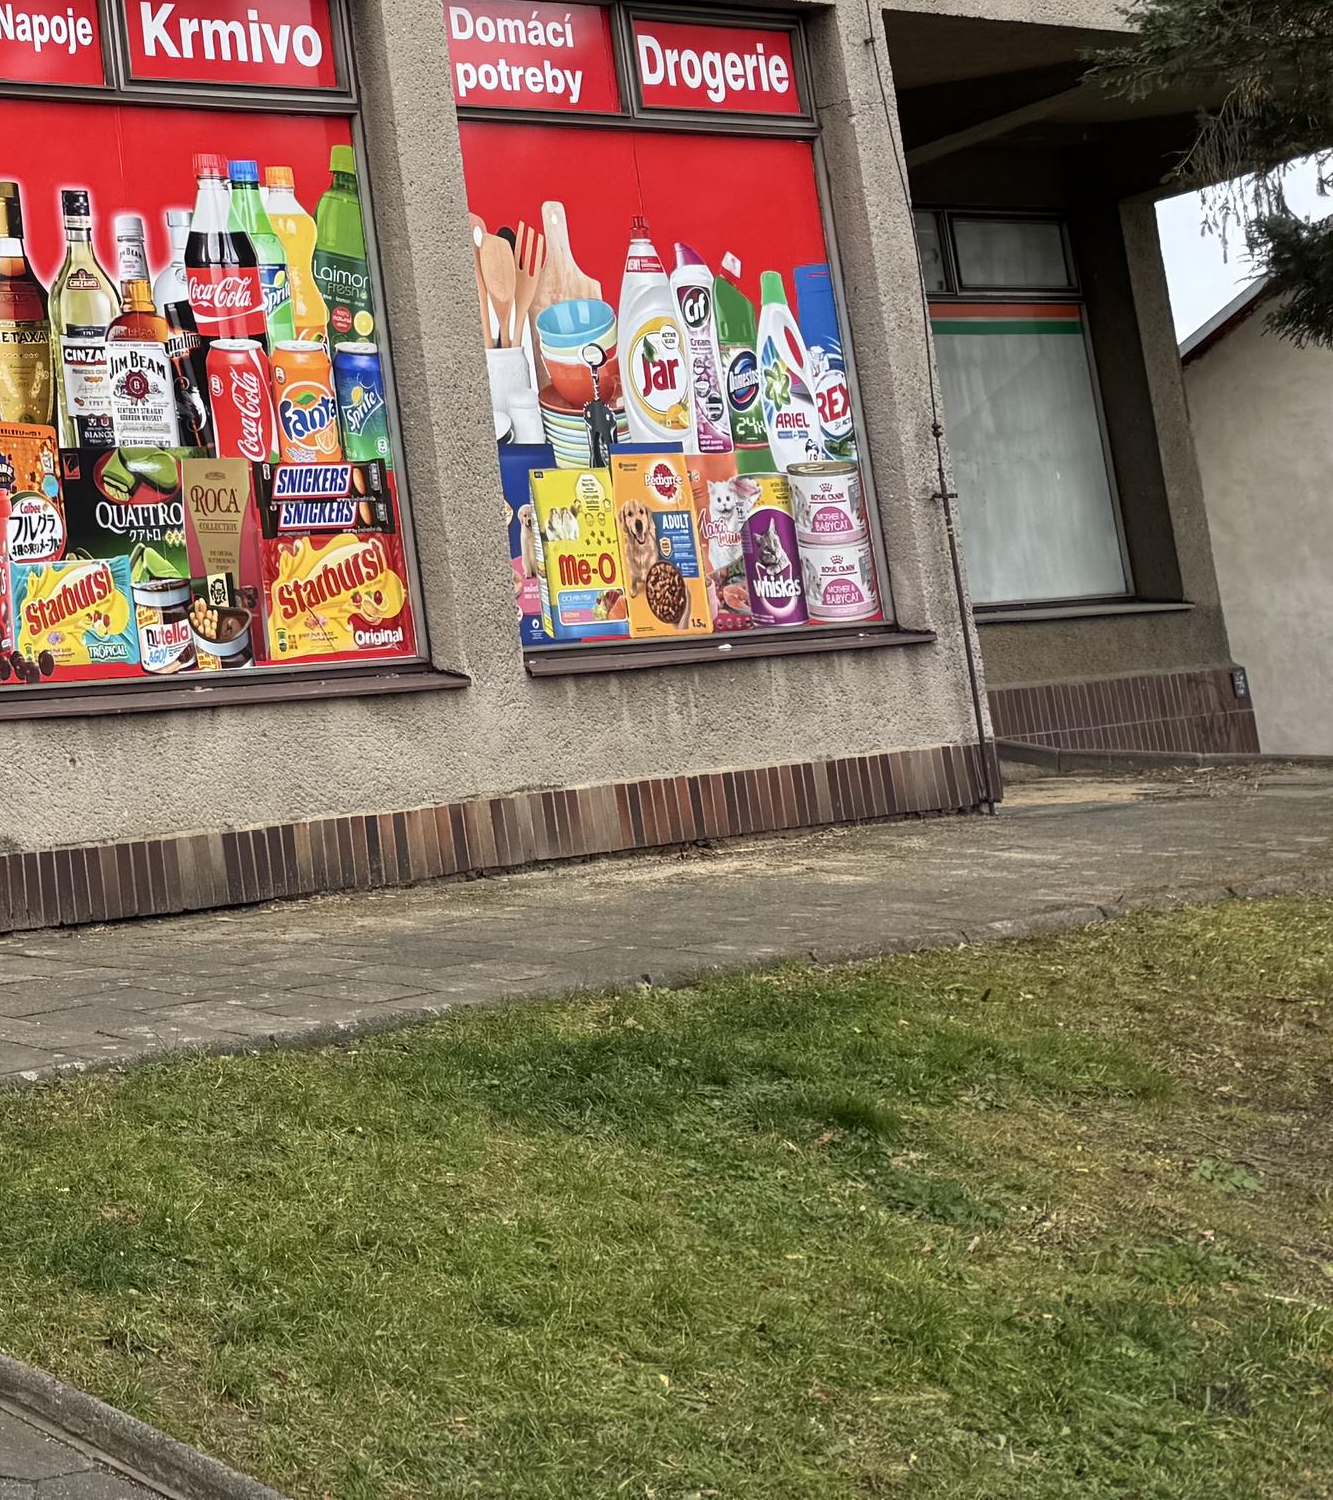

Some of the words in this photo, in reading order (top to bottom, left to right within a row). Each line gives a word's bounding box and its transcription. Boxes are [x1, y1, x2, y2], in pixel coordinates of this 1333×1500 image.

[139, 1, 323, 67] Krmivo
[448, 6, 574, 48] Domácí
[455, 58, 583, 104] potreby
[636, 34, 790, 103] Drogerie
[262, 283, 291, 314] Sprit
[684, 293, 706, 324] Cif
[109, 355, 128, 380] JIM
[130, 351, 166, 381] BEAM
[642, 353, 679, 398] Jar
[776, 412, 810, 429] ARIEL
[277, 467, 349, 494] SNICKERS
[644, 474, 683, 488] Pedigree
[20, 502, 41, 514] Calbee
[190, 485, 241, 516] ROCA
[283, 501, 353, 525] SNICKERS
[9, 514, 56, 544] フルグラ
[96, 501, 183, 534] QUATTRO
[199, 522, 237, 531] COLLECTION
[662, 513, 690, 530] ADULT
[815, 519, 849, 532] BABYCAT
[129, 528, 162, 542] クアトロ
[278, 541, 384, 620] Starburst
[753, 575, 802, 598] whiskas
[25, 563, 112, 636] Starburst
[825, 591, 860, 605] BABYCAT
[146, 622, 189, 647] nutella
[355, 627, 404, 647] Original
[88, 644, 127, 660] TROPICAL
